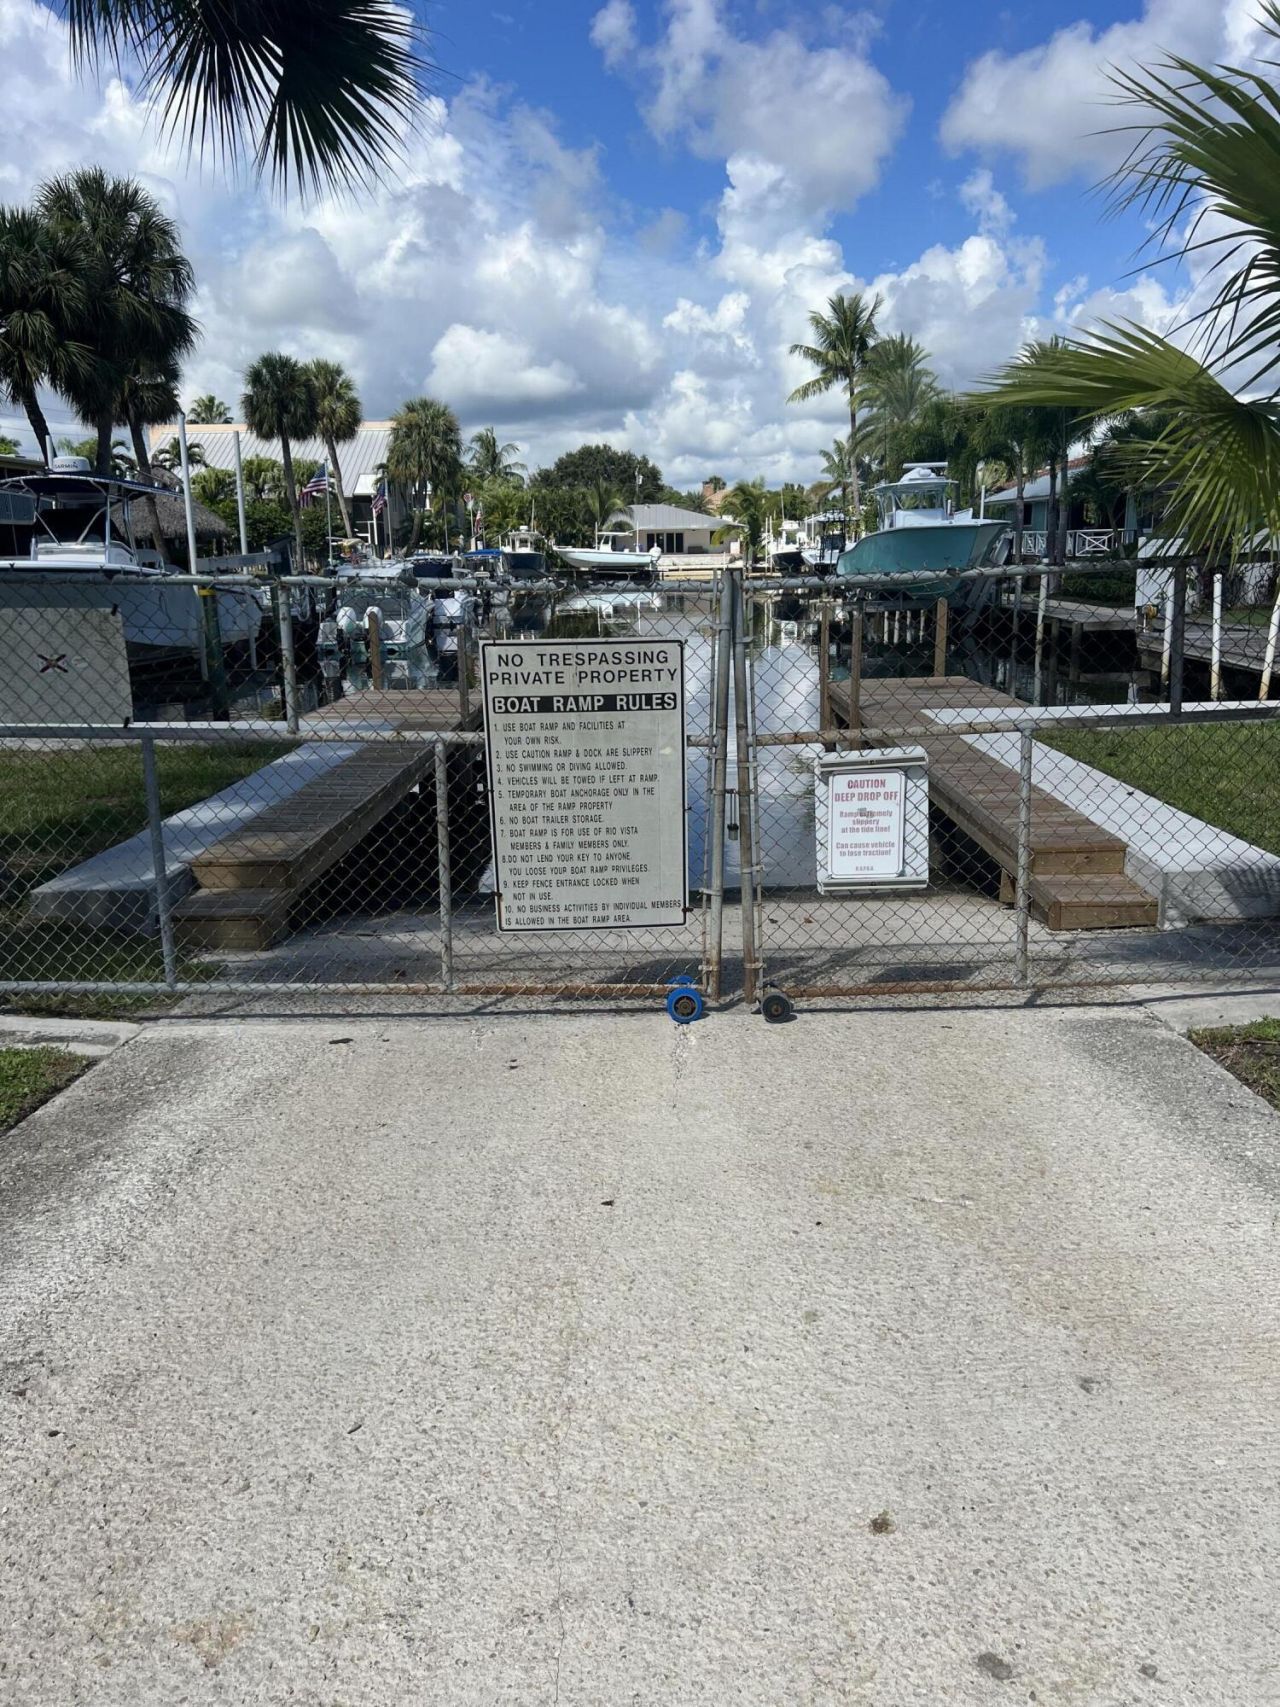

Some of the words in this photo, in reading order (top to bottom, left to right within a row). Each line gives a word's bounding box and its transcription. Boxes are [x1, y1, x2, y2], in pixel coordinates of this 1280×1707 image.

[498, 653, 523, 667] NO
[537, 650, 668, 667] TRESPASSING
[489, 671, 565, 685] PRIVATE
[578, 668, 677, 684] PROPERTY
[494, 697, 540, 713] BOAT
[553, 695, 604, 712] RAMP
[616, 693, 675, 711] RULES
[494, 723, 499, 732] 1.
[502, 722, 516, 732] USE
[519, 722, 536, 732] BOAT
[540, 721, 558, 732] RAMP
[562, 721, 576, 731] AND
[579, 720, 614, 730] FACILITIES
[618, 720, 625, 729] AT
[504, 736, 521, 745] YOUR
[525, 736, 541, 745] OWN
[544, 735, 561, 745] RISK.
[495, 750, 501, 759] 2.
[505, 749, 518, 759] USE
[521, 749, 550, 758] CAUTION
[553, 749, 572, 758] RAMP
[575, 748, 579, 758] &
[583, 748, 602, 757] DOCK
[606, 747, 619, 757] ARE
[622, 746, 653, 756] SLIPPERY
[496, 763, 502, 772] 3.
[506, 763, 516, 772] NO
[519, 762, 553, 772] SWIMMING
[556, 762, 566, 771] OR
[569, 761, 591, 771] DIVING
[594, 760, 628, 770] ALLOWED.
[497, 777, 503, 785] 4.
[507, 777, 538, 785] VEHICLES
[541, 776, 558, 785] WILL
[560, 776, 569, 785] BE
[572, 775, 596, 784] TOWED
[599, 775, 606, 784] IF
[609, 774, 625, 784] LEFT
[628, 774, 636, 783] AT
[639, 773, 659, 783] RAMP.
[847, 779, 886, 789] CAUTION
[498, 790, 504, 799] 5.
[507, 789, 547, 798] TEMPORARY
[550, 789, 567, 798] BOAT
[570, 788, 610, 798] ANCHORAGE
[613, 788, 629, 797] ONLY
[632, 787, 639, 796] IN
[642, 787, 655, 796] THE
[834, 792, 856, 802] DEEP
[857, 791, 882, 801] DROP
[883, 791, 898, 801] OFF
[509, 803, 526, 811] AREA
[529, 803, 539, 811] OF
[542, 802, 555, 811] THE
[557, 802, 576, 811] RAMP
[579, 801, 613, 810] PROPERTY
[499, 816, 506, 825] 6.
[509, 816, 519, 825] NO
[522, 816, 539, 825] BOAT
[542, 815, 569, 824] TRAILER
[500, 829, 505, 838] 7.
[509, 829, 526, 838] BOAT
[529, 829, 548, 837] RAMP
[551, 828, 558, 837] IS
[561, 828, 574, 837] FOR
[577, 827, 590, 837] USE
[593, 827, 602, 836] OF
[605, 827, 617, 835] RIO
[620, 826, 639, 835] VISTA
[510, 842, 541, 850] MEMBERS
[544, 841, 550, 850] &
[553, 841, 575, 849] FAMILY
[578, 840, 610, 849] MEMBERS
[612, 839, 630, 848] ONLY.
[871, 840, 895, 848] vehicle
[520, 855, 533, 863] NOT
[537, 855, 553, 863] LEND
[556, 854, 574, 863] YOUR
[577, 853, 590, 862] KEY
[593, 853, 602, 861] TO
[508, 868, 521, 876] YOU
[525, 867, 547, 876] LOOSE
[550, 867, 567, 875] YOUR
[570, 866, 587, 875] BOAT
[590, 866, 608, 874] RAMP
[532, 880, 553, 888] FENCE
[556, 879, 590, 888] ENTRANCE
[592, 878, 618, 887] LOCKED
[621, 878, 640, 886] WHEN
[512, 893, 526, 901] NOT
[538, 892, 553, 900] USE.
[505, 906, 514, 914] 10.
[517, 905, 527, 914] NO
[529, 905, 561, 913] BUSINESS
[563, 903, 598, 912] ACTIVITIES
[601, 903, 610, 911] BY
[613, 902, 648, 911] INDIVIDUAL
[650, 900, 682, 909] MEMBERS
[505, 917, 512, 926] IS
[514, 917, 545, 926] ALLOWED
[548, 917, 555, 925] IN
[557, 917, 570, 925] THE
[573, 916, 590, 925] BOAT
[592, 916, 610, 924] RAMP
